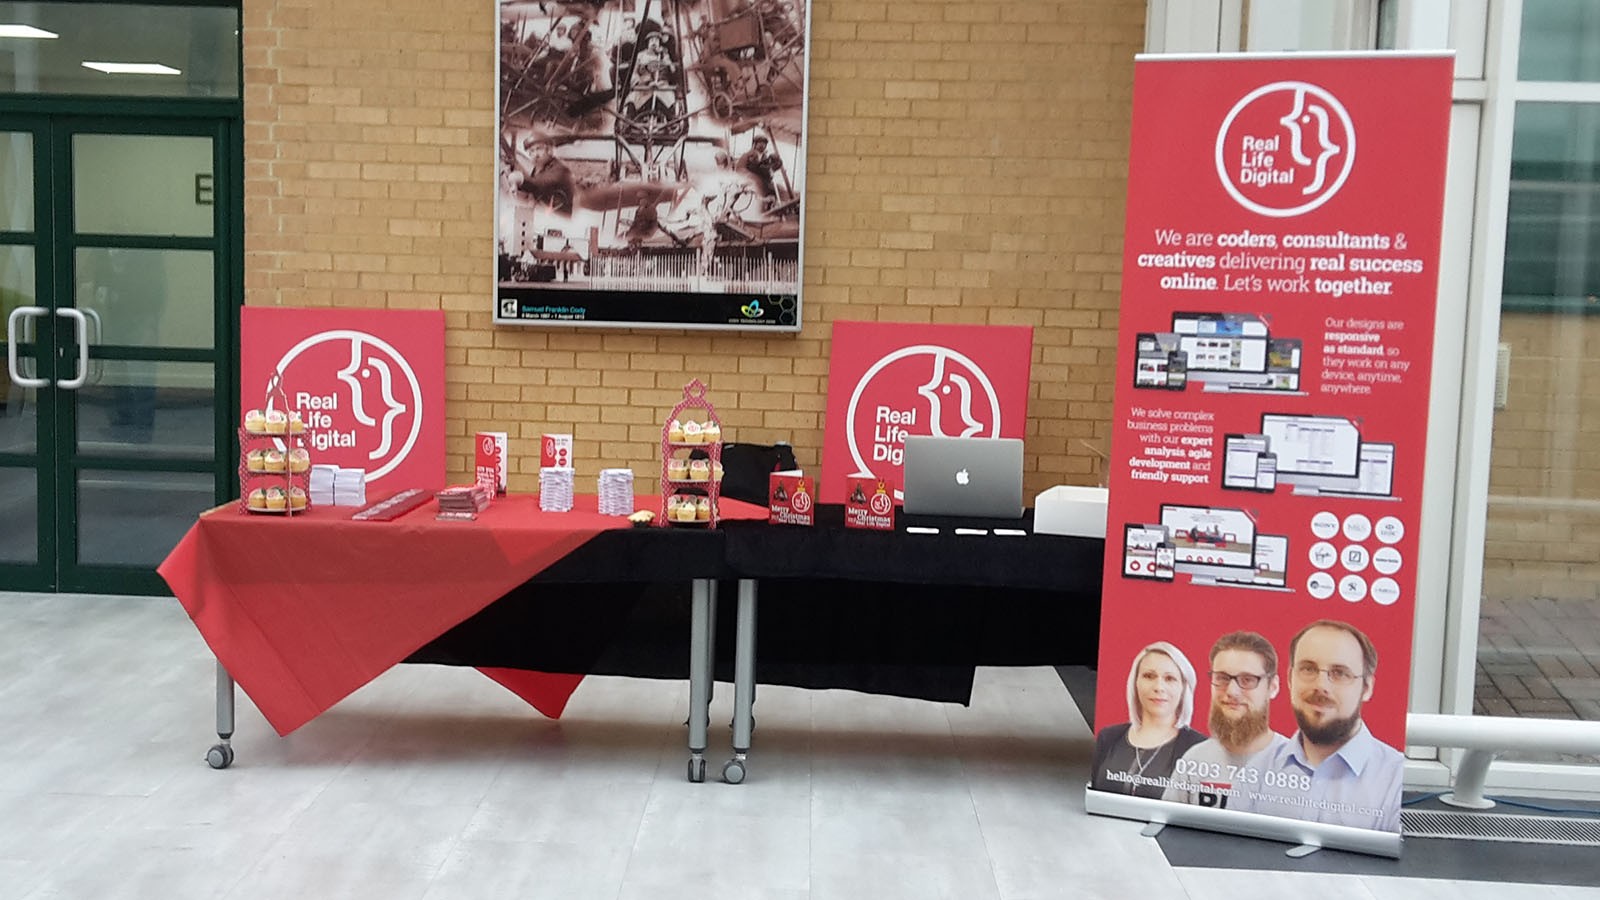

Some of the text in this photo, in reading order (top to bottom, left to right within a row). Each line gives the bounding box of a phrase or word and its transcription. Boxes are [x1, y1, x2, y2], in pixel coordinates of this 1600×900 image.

[1242, 135, 1280, 151] Real
[1241, 152, 1274, 168] Life
[1240, 168, 1294, 187] Digital
[1155, 229, 1408, 250] We are coders, consultants &
[1137, 251, 1424, 274] creatives delivering real success
[1160, 273, 1393, 298] online. Let's work together.
[1325, 317, 1405, 331] Our designs are
[1324, 331, 1380, 343] responsive
[1323, 345, 1336, 354] as
[1387, 347, 1400, 356] so
[1322, 355, 1411, 372] they work on any
[296, 392, 338, 410] Real
[876, 406, 916, 425] Real
[1131, 407, 1215, 422] We solve complex
[875, 425, 909, 443] Life
[1127, 419, 1214, 434] business problems
[1139, 433, 1213, 447] with our expert
[1188, 448, 1213, 460] agile
[1129, 456, 1211, 471] development and
[1131, 469, 1209, 485] friendly support
[771, 505, 790, 514] Merry
[780, 511, 811, 521] Christmas
[848, 507, 868, 516] Merry
[857, 514, 891, 523] Christmas
[1175, 758, 1311, 792] 0203 743 0888
[1106, 769, 1240, 798] hello@reallifedigital.com
